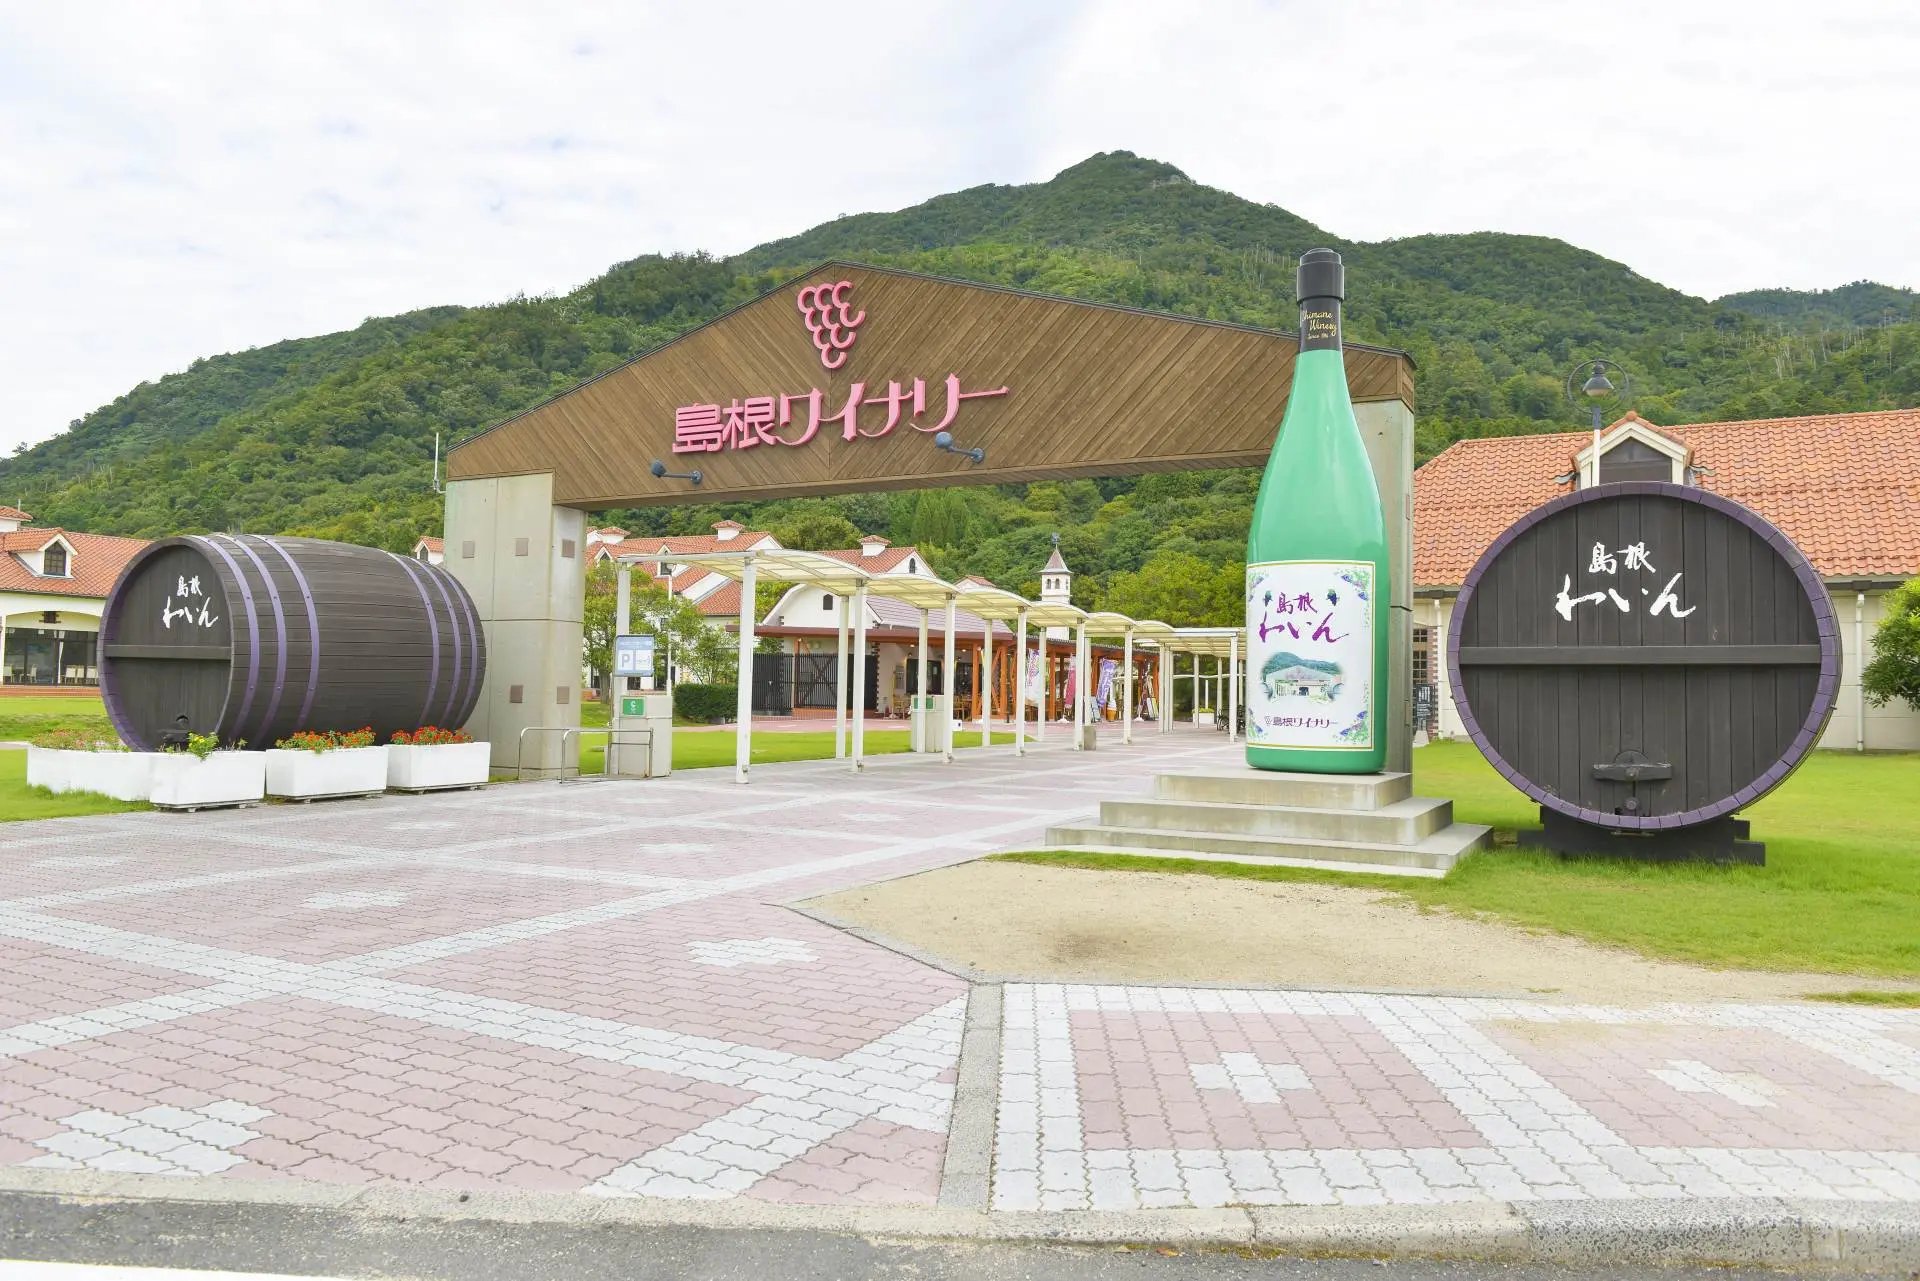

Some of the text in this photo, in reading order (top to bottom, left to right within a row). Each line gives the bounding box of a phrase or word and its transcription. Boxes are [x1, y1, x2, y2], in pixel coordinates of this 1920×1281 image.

[672, 372, 1010, 454] 島根ワイナリー
[1588, 542, 1656, 574] 島根
[163, 596, 219, 628] わいん
[1276, 592, 1318, 615] 島根
[1555, 573, 1696, 621] わいん
[1259, 611, 1349, 643] わいん
[622, 654, 630, 667] P
